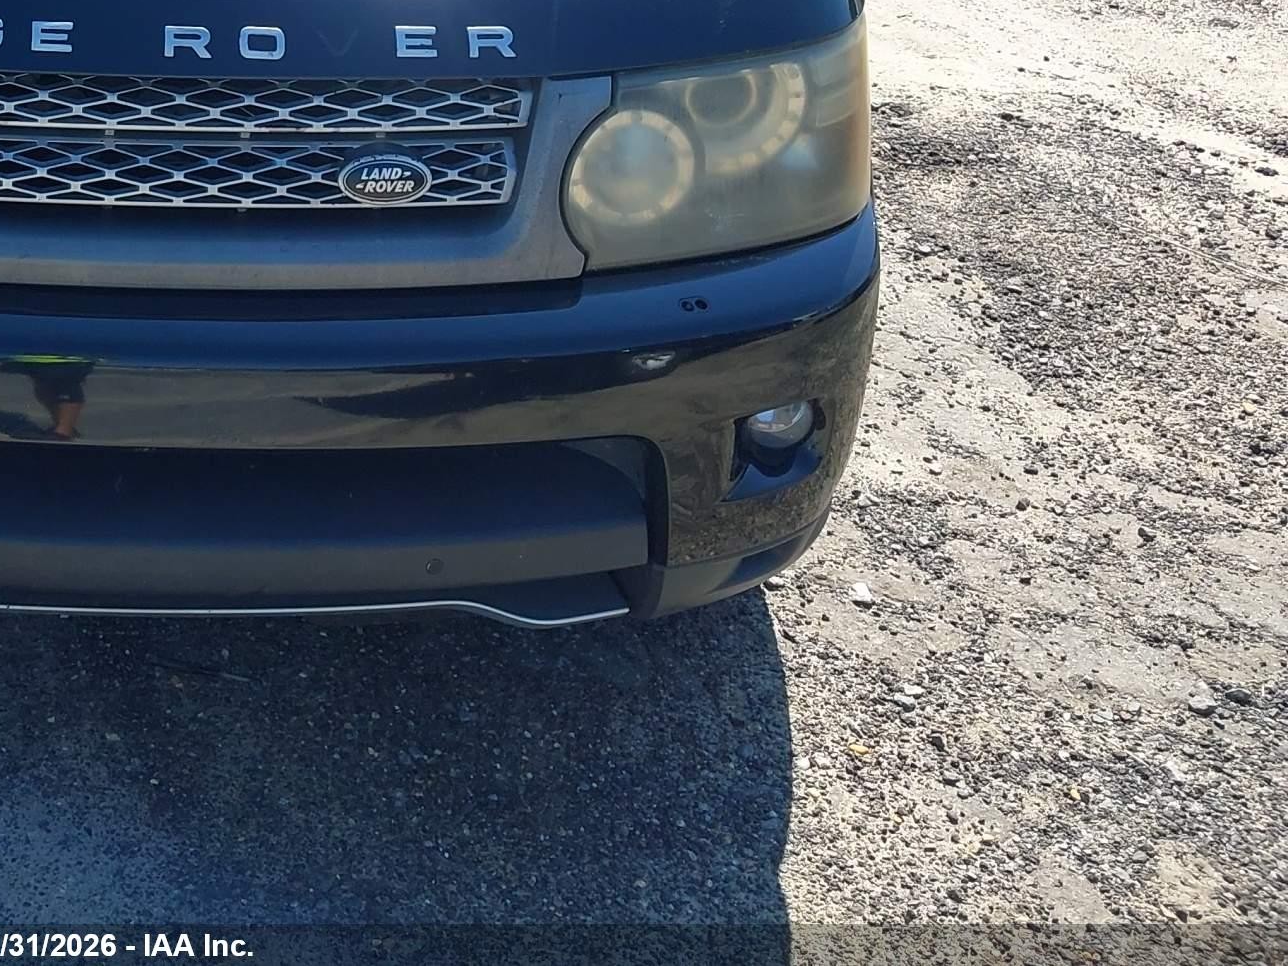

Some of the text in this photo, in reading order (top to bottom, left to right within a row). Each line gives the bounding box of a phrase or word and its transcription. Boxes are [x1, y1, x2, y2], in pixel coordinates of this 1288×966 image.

[163, 24, 517, 61] ROER
[360, 167, 403, 180] LAND
[364, 180, 415, 193] ROVER
